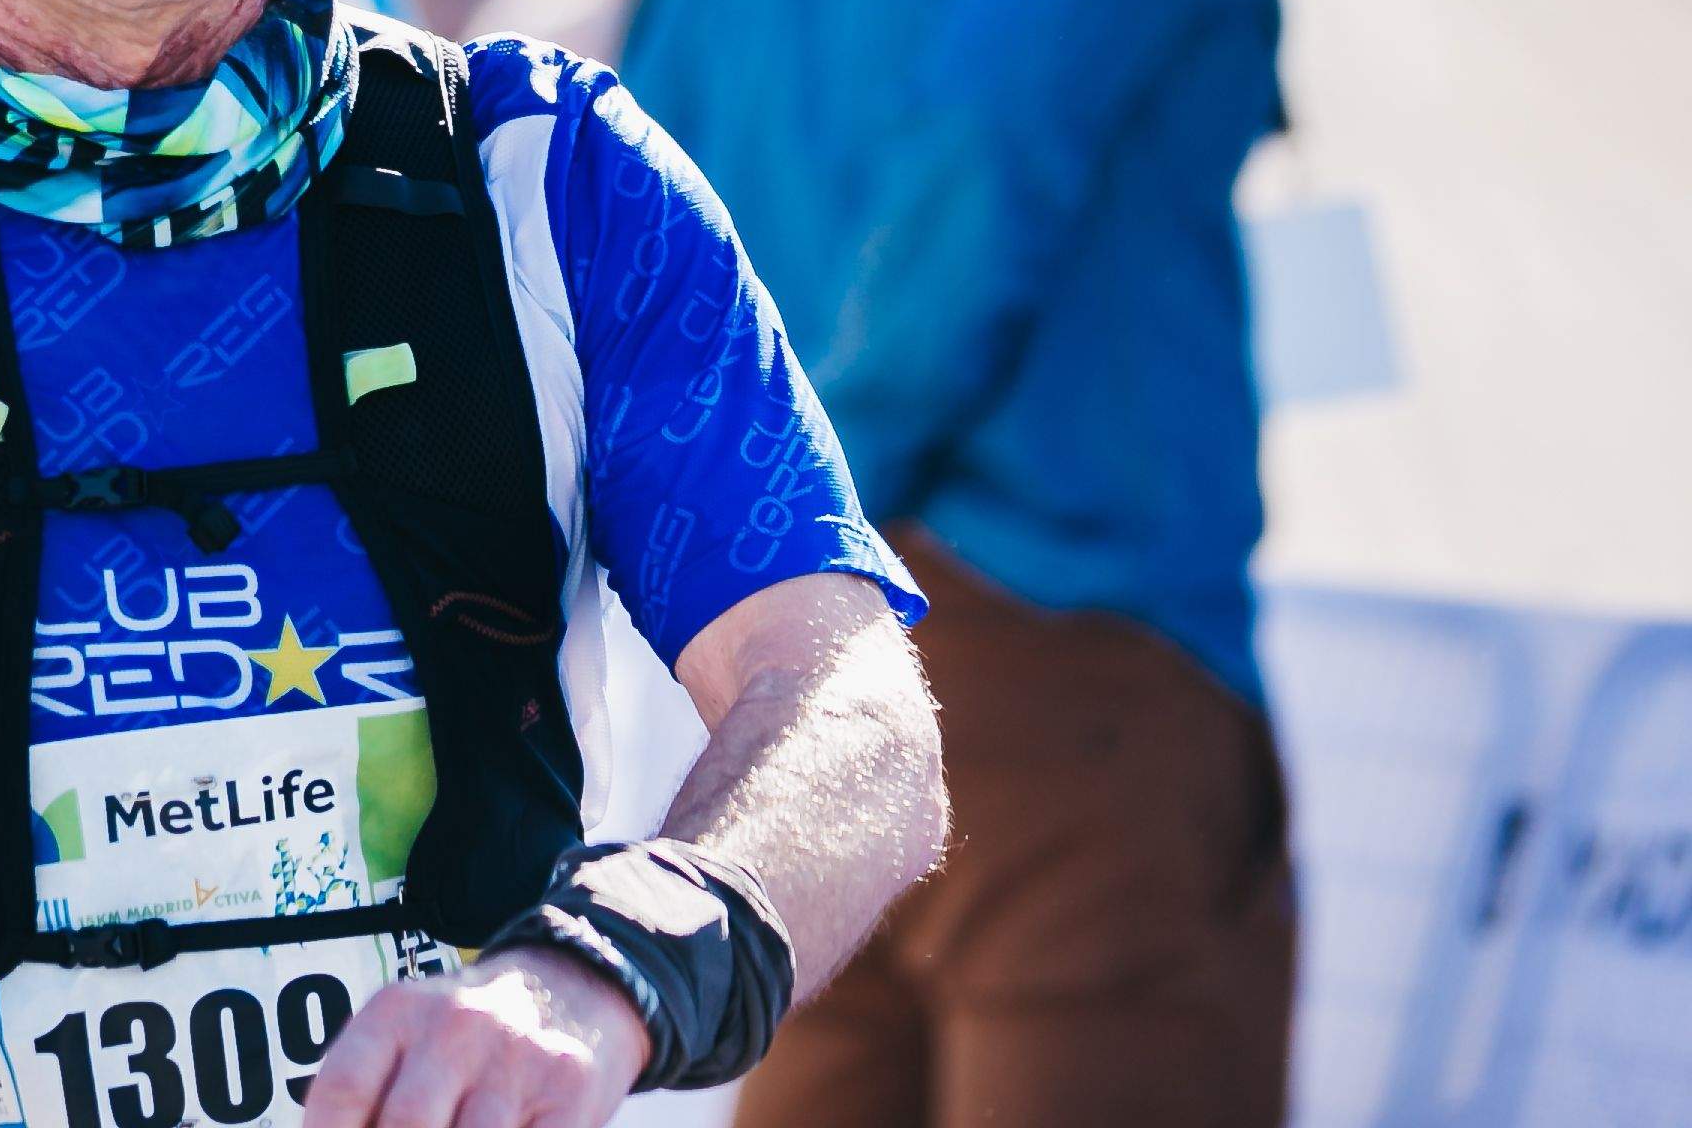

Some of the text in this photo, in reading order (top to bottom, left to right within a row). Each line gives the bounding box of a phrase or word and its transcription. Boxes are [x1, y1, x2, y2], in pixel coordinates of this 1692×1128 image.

[105, 769, 335, 842] MetLife
[126, 898, 194, 921] MADRID
[34, 973, 353, 1128] 1309
